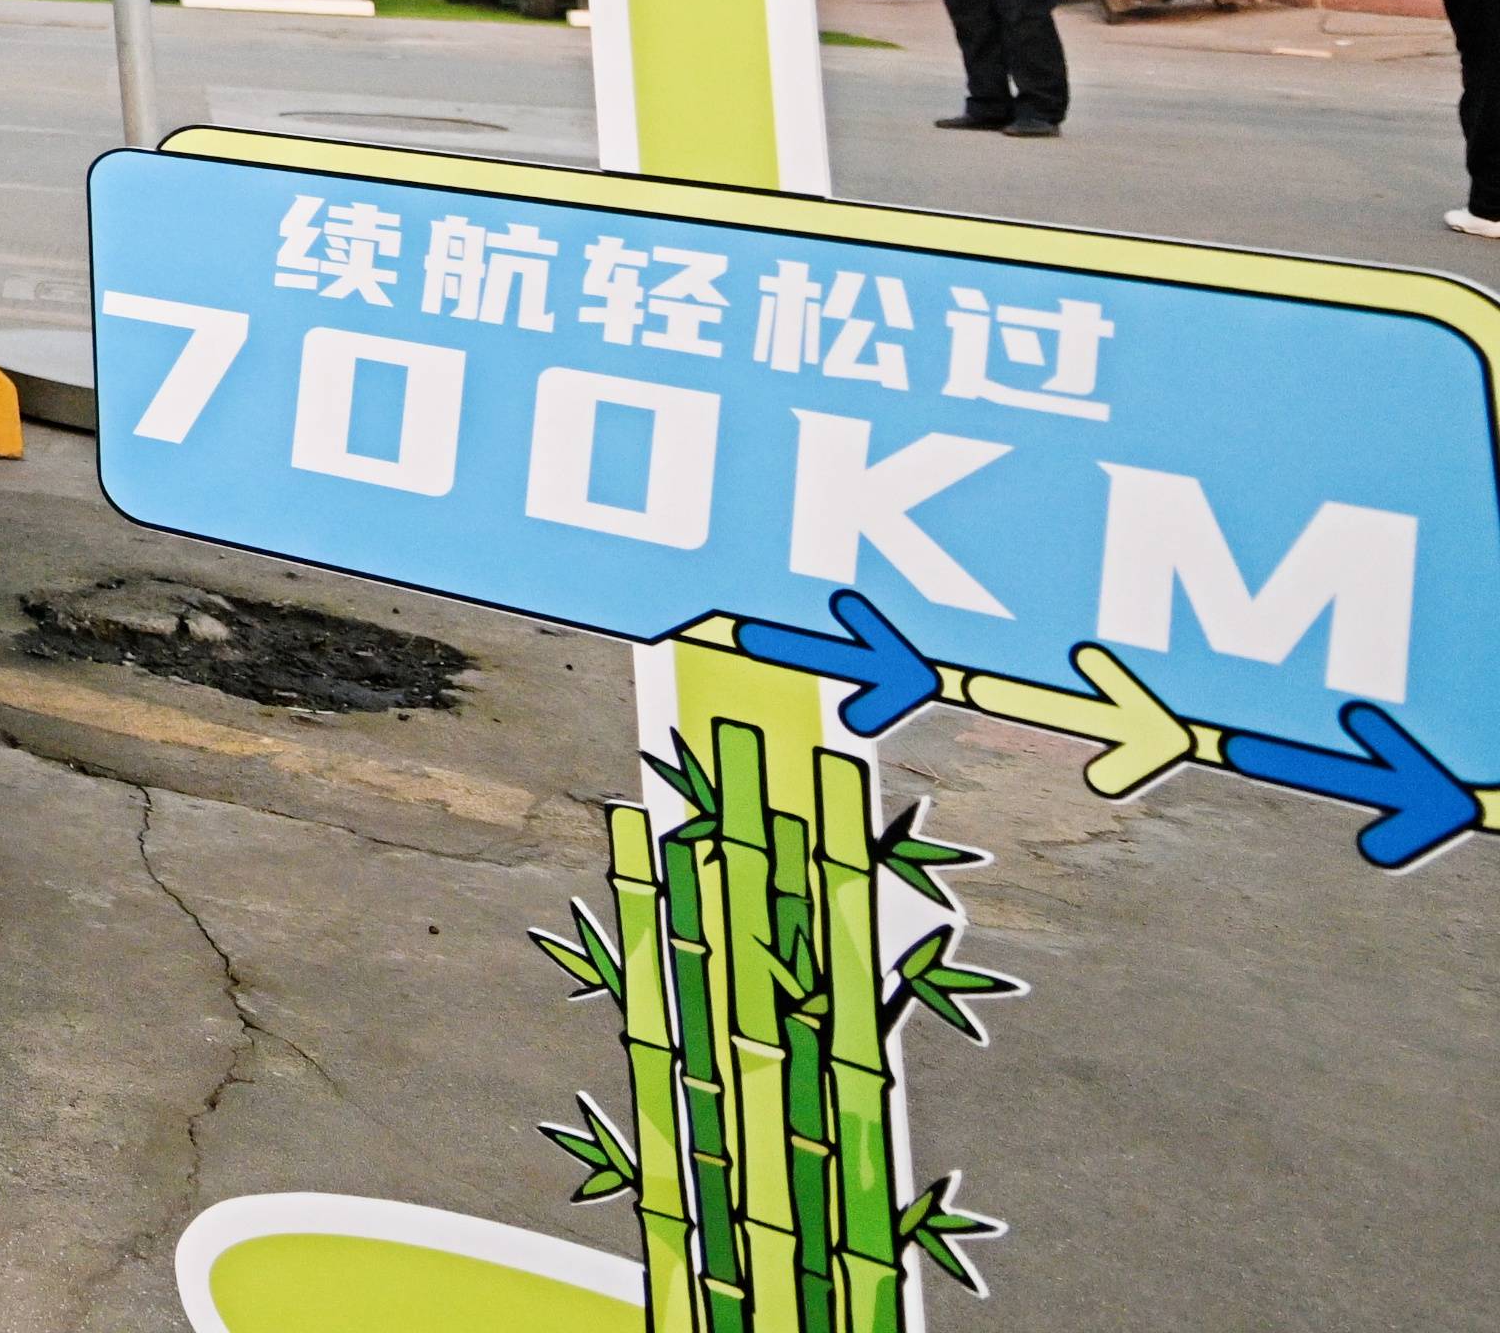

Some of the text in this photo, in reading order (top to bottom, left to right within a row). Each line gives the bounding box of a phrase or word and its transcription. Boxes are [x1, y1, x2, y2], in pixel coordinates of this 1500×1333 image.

[274, 193, 1114, 421] 续航轻松过
[100, 290, 1418, 705] 700KM
